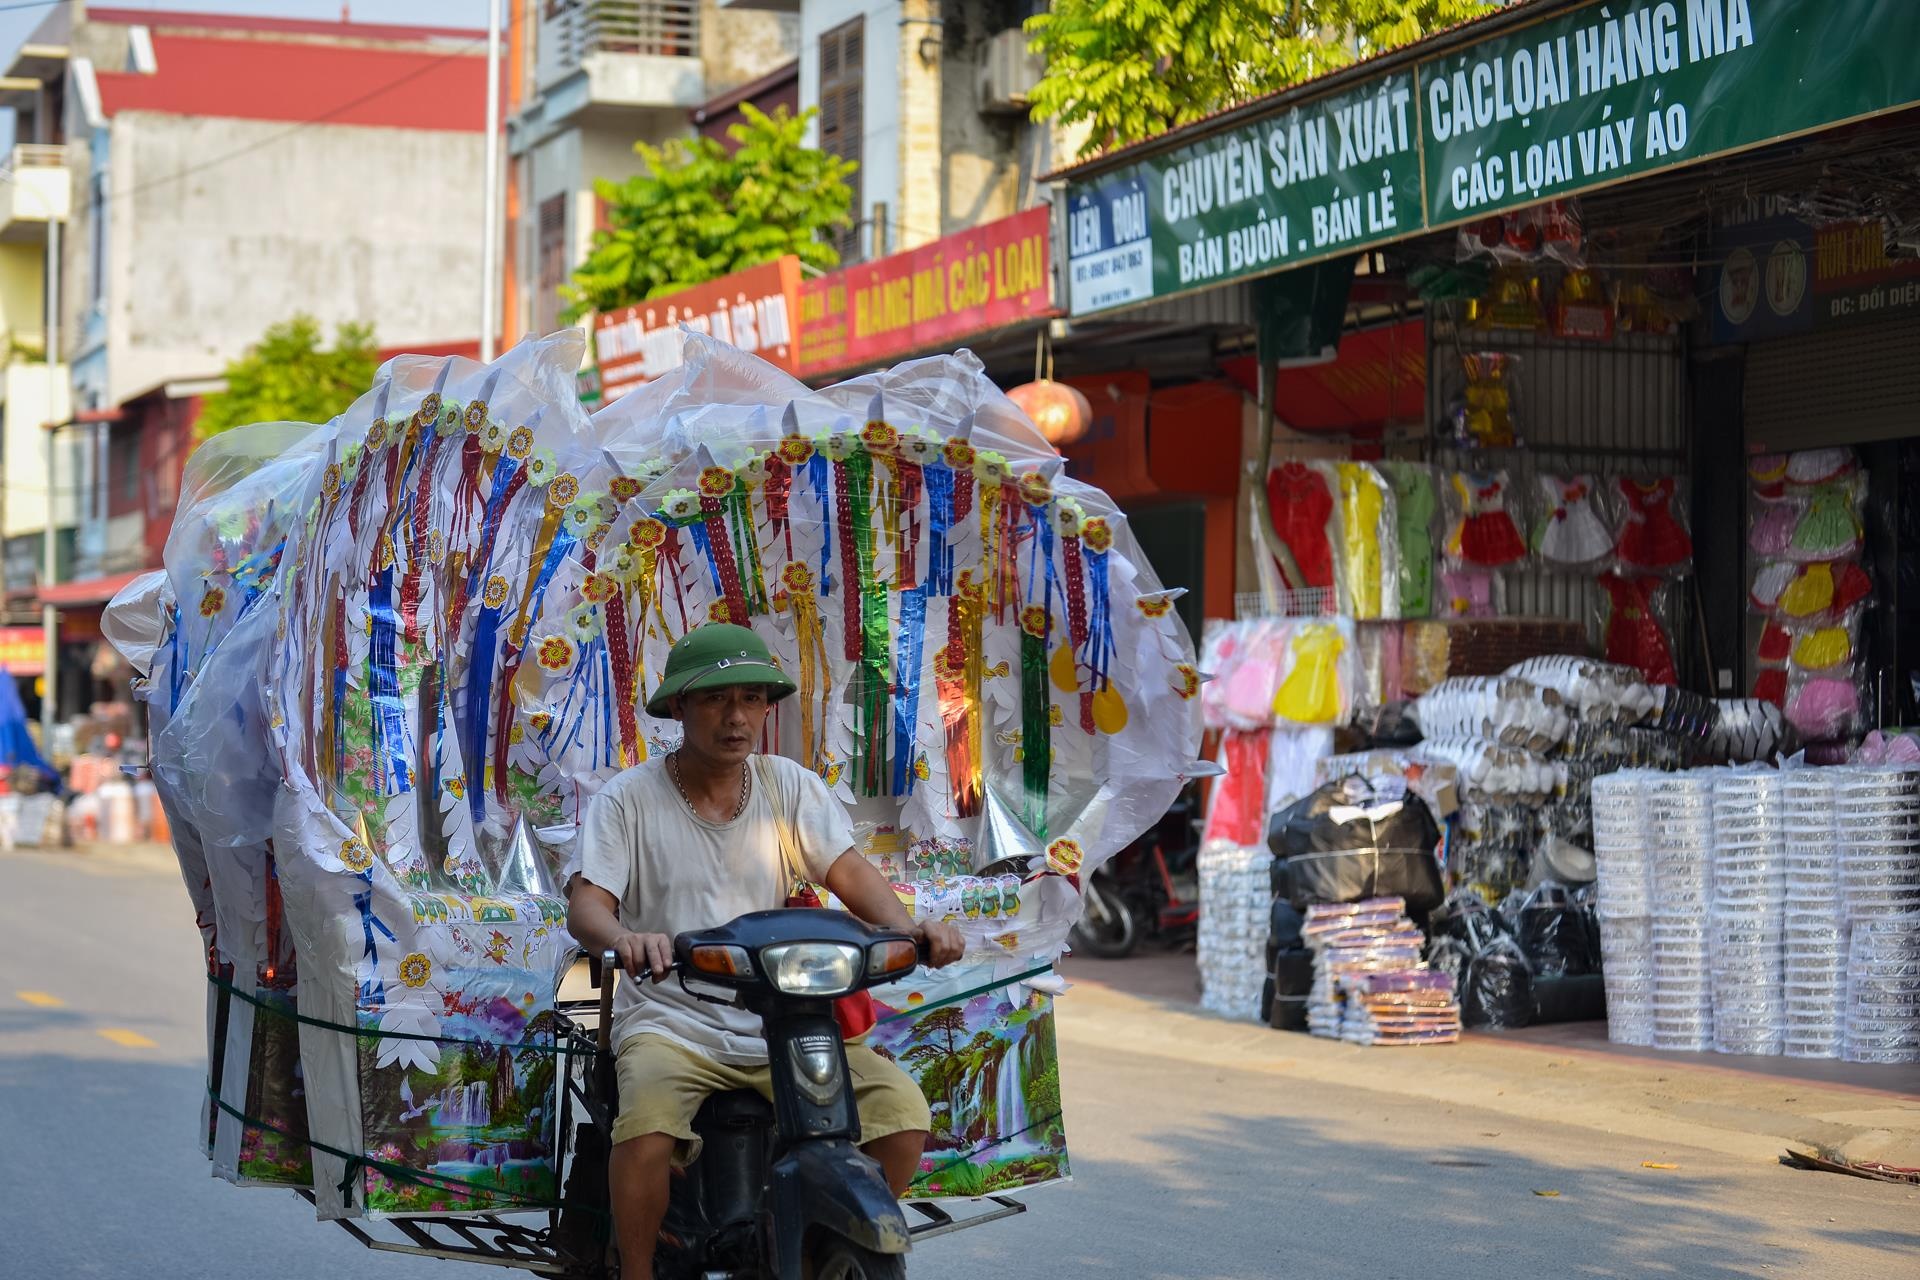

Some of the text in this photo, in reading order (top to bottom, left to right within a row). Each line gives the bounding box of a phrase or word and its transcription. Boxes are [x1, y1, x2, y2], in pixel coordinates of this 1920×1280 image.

[1575, 2, 1680, 97] HÀNG
[1163, 75, 1410, 225] CHUYÊN SẢN XUẤT
[1451, 146, 1505, 211] CÁC
[1577, 105, 1635, 176] VÁY
[1645, 88, 1687, 160] ÁO
[1178, 229, 1224, 284] BÁN
[1227, 207, 1289, 271] BUÔN
[1311, 186, 1362, 248] BÁN
[1367, 168, 1397, 234] LẺ
[855, 270, 911, 338] HÀNG
[949, 240, 991, 315] CÁC
[994, 234, 1043, 307] LOẠI
[800, 1035, 831, 1043] HONDA
